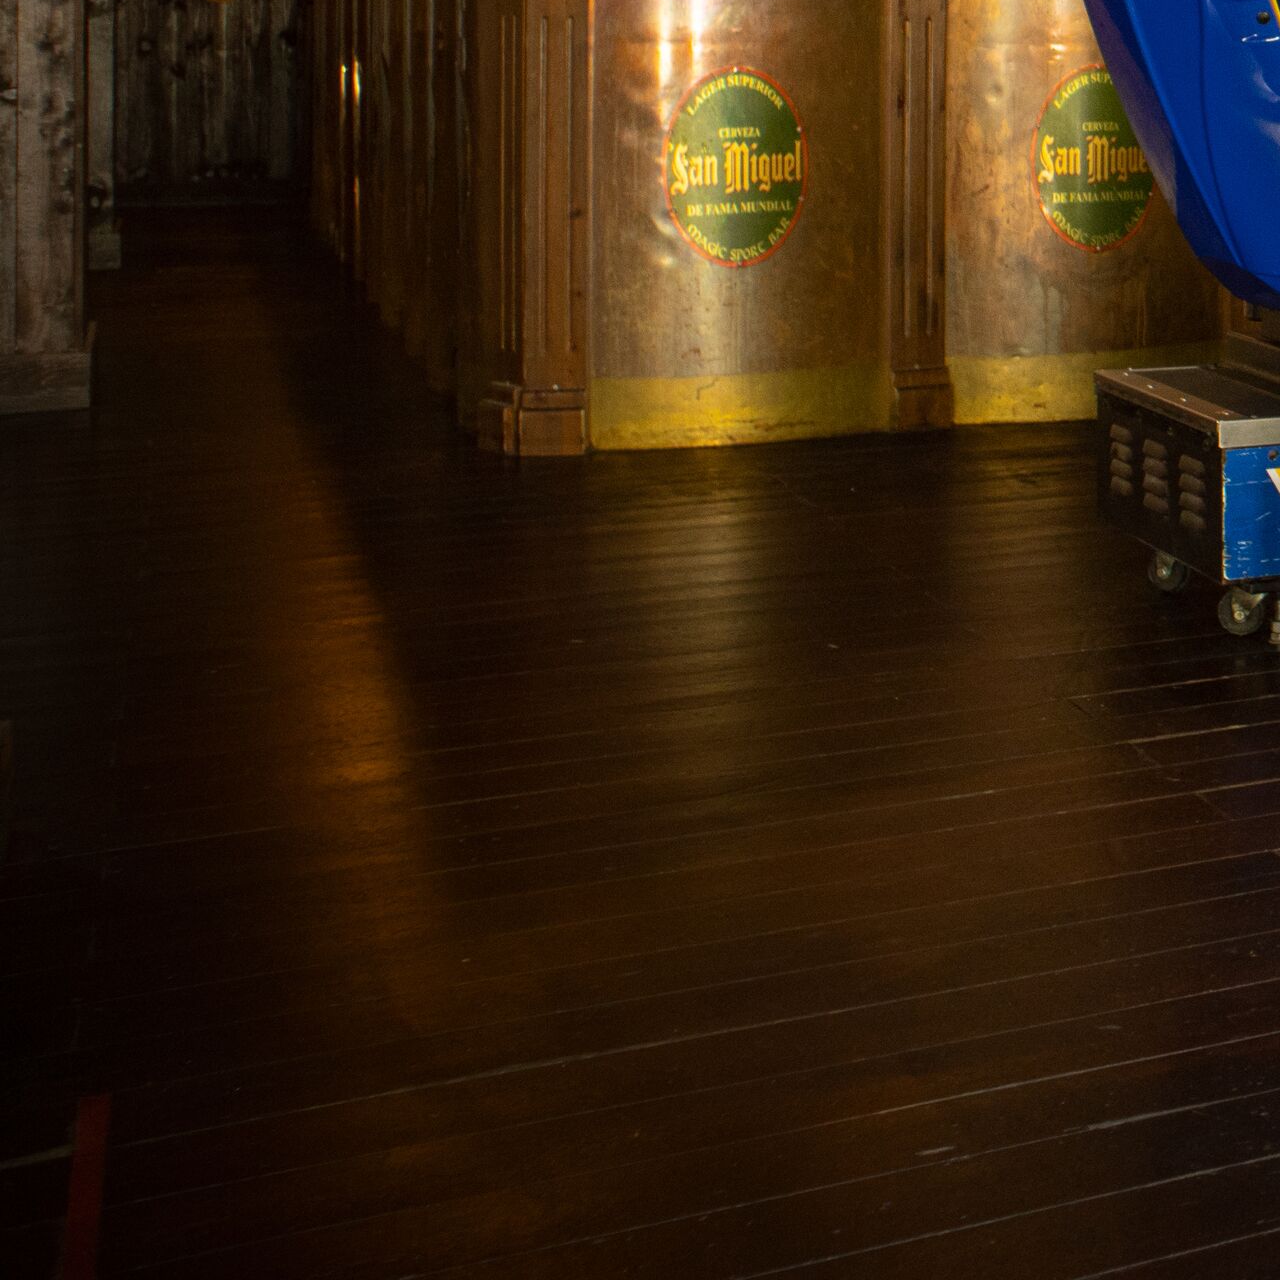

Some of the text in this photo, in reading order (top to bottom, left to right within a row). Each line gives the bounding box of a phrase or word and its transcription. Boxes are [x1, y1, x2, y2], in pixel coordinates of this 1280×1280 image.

[686, 74, 784, 116] LAGER SUPERIOR
[1053, 74, 1090, 110] LAGER
[718, 127, 761, 138] CERVEZA
[1081, 121, 1120, 131] CERVEZA
[669, 140, 802, 195] San Miguel
[1038, 134, 1150, 184] San Migue
[686, 200, 793, 217] DE FAMA MUNDIAL
[1052, 191, 1067, 203] DE
[1069, 190, 1100, 202] FAMA
